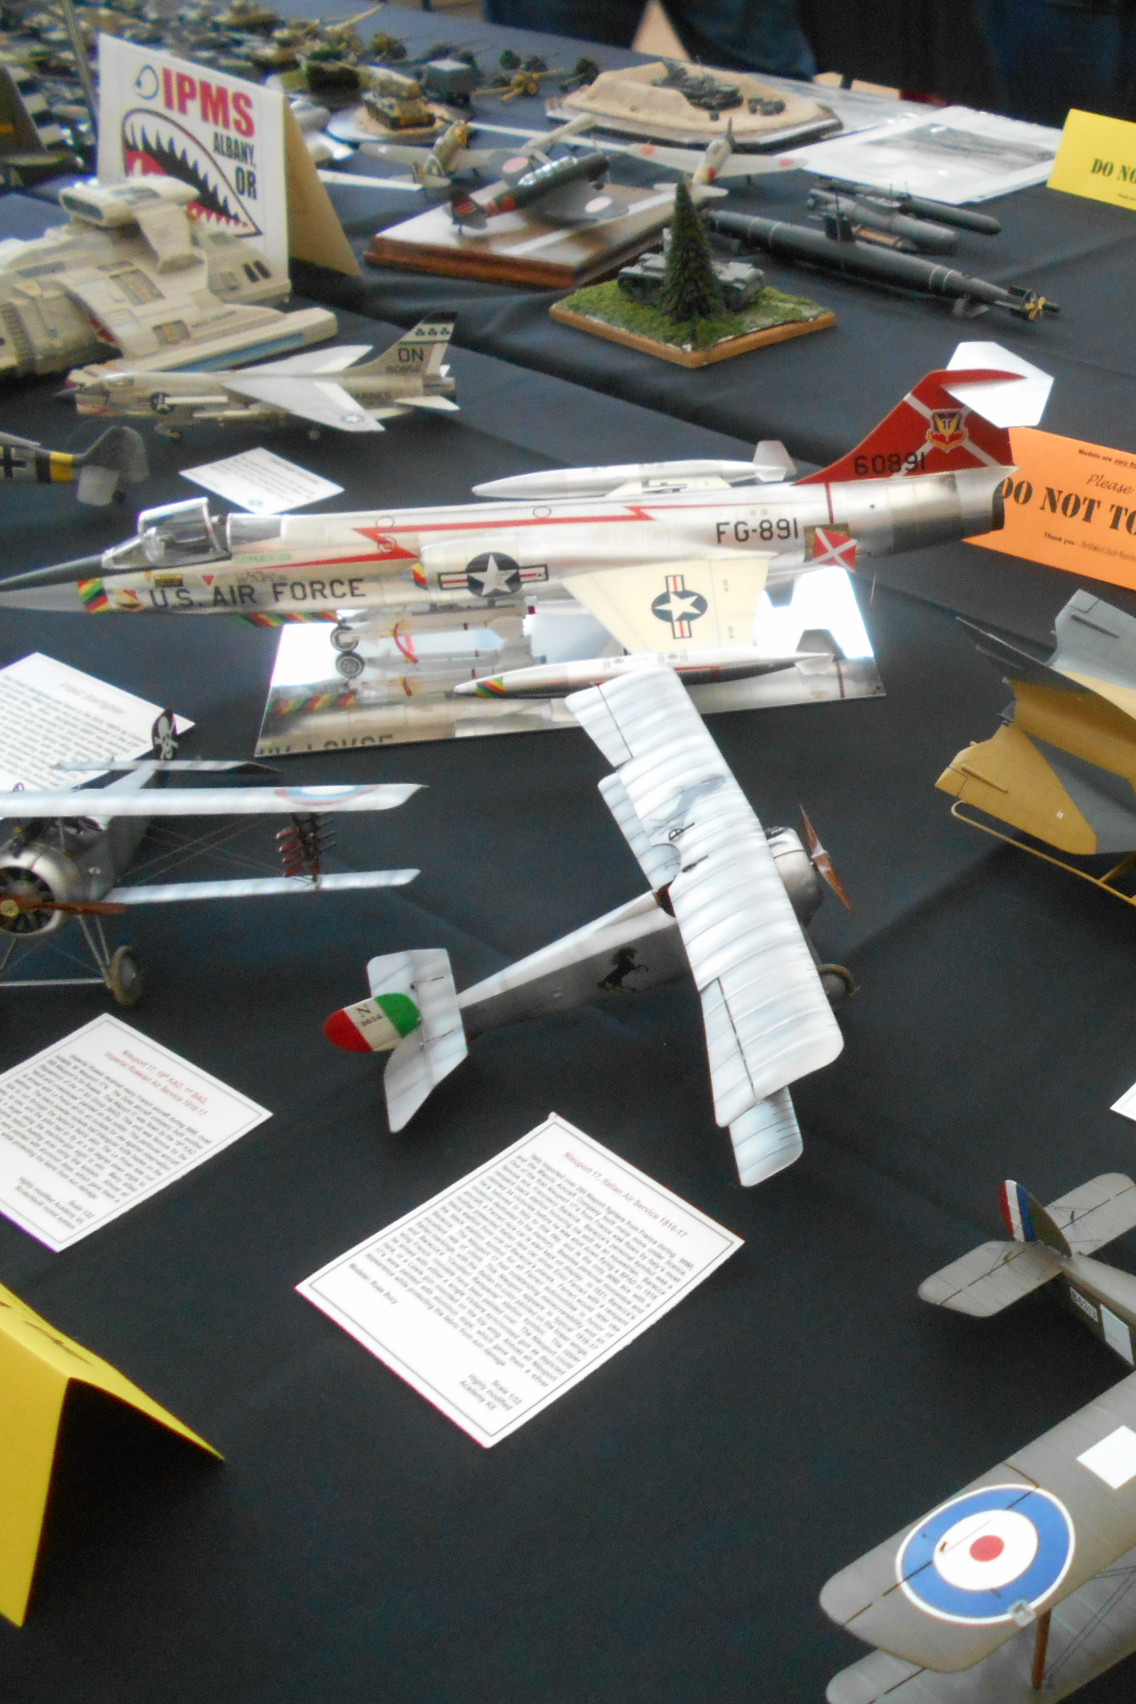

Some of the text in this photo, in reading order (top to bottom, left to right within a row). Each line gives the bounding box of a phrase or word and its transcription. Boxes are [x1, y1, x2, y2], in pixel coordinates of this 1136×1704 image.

[163, 67, 255, 138] IPMS
[1090, 157, 1115, 177] DO
[235, 166, 257, 199] OR
[854, 451, 926, 477] 60891
[1085, 473, 1133, 495] Please
[1039, 486, 1101, 523] NOT
[715, 517, 799, 545] FG-891
[149, 588, 203, 609] U.S.
[212, 584, 256, 606] AIR
[272, 577, 366, 603] FORCE
